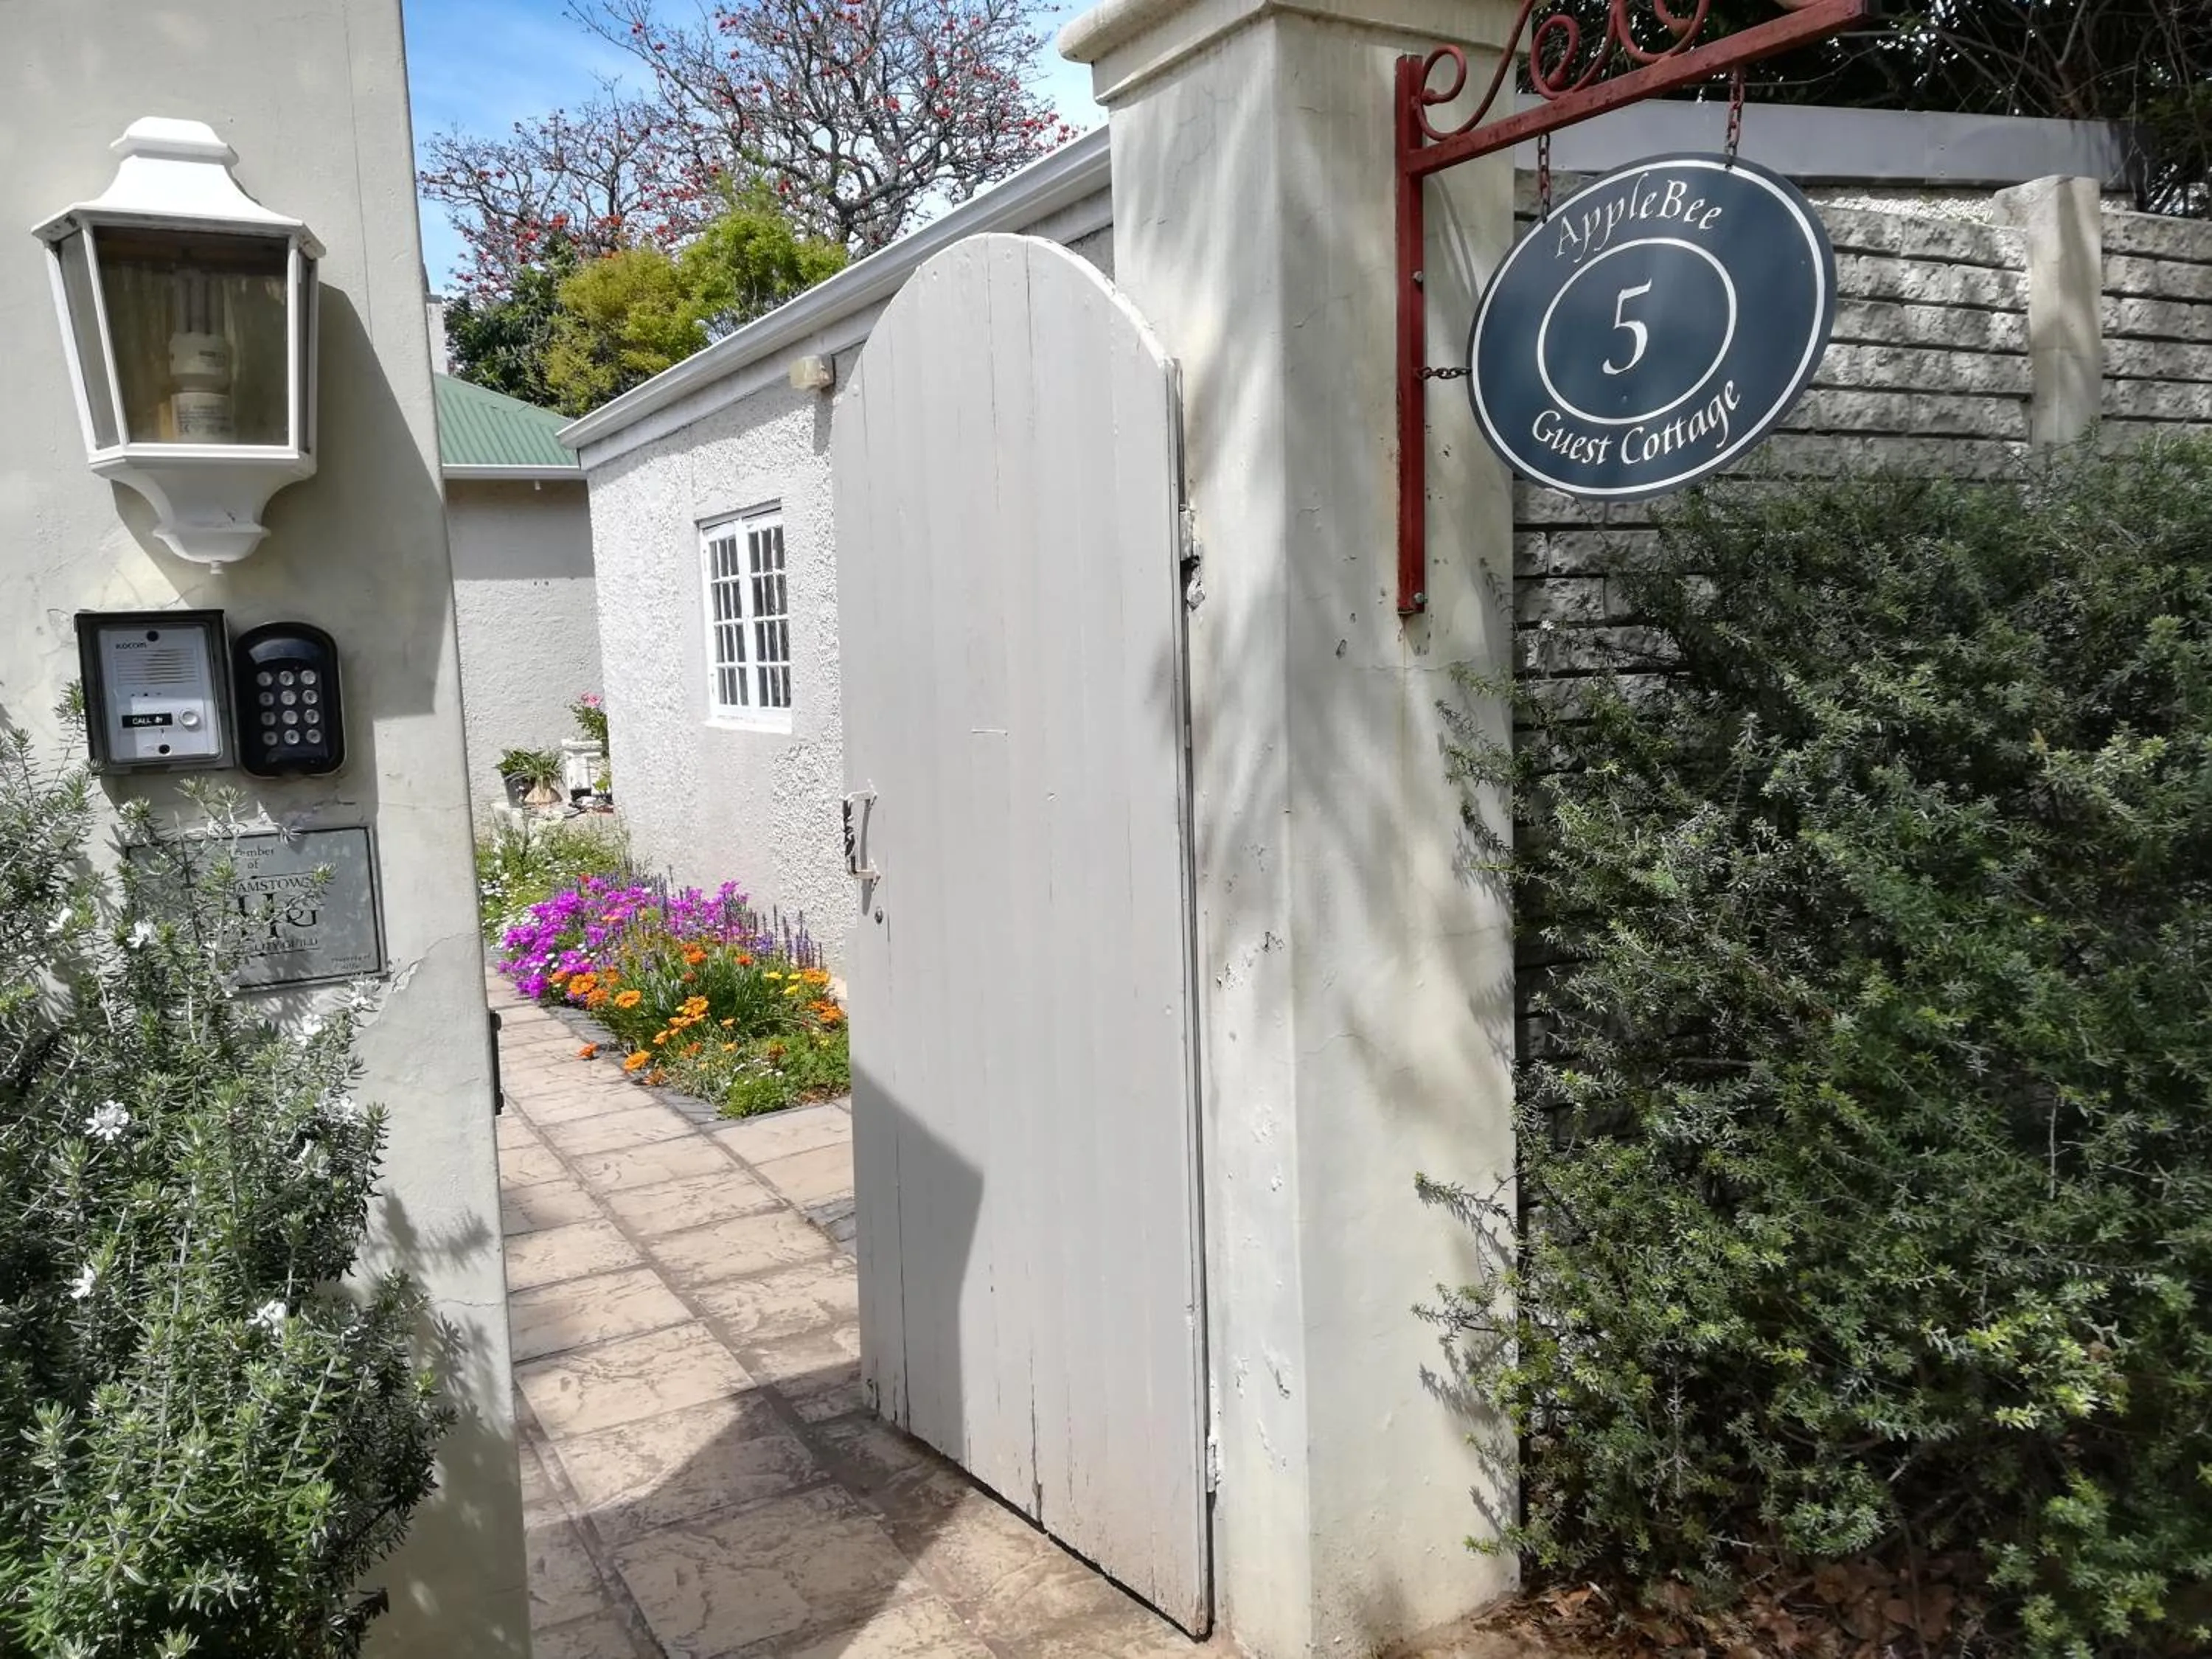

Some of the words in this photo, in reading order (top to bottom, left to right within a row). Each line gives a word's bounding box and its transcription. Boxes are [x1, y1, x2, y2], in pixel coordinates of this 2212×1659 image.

[1555, 170, 1723, 264] AppleBee
[1601, 278, 1652, 375] 5
[1532, 409, 1611, 465] Guest
[1621, 379, 1741, 465] Cottage
[132, 717, 152, 725] CALL
